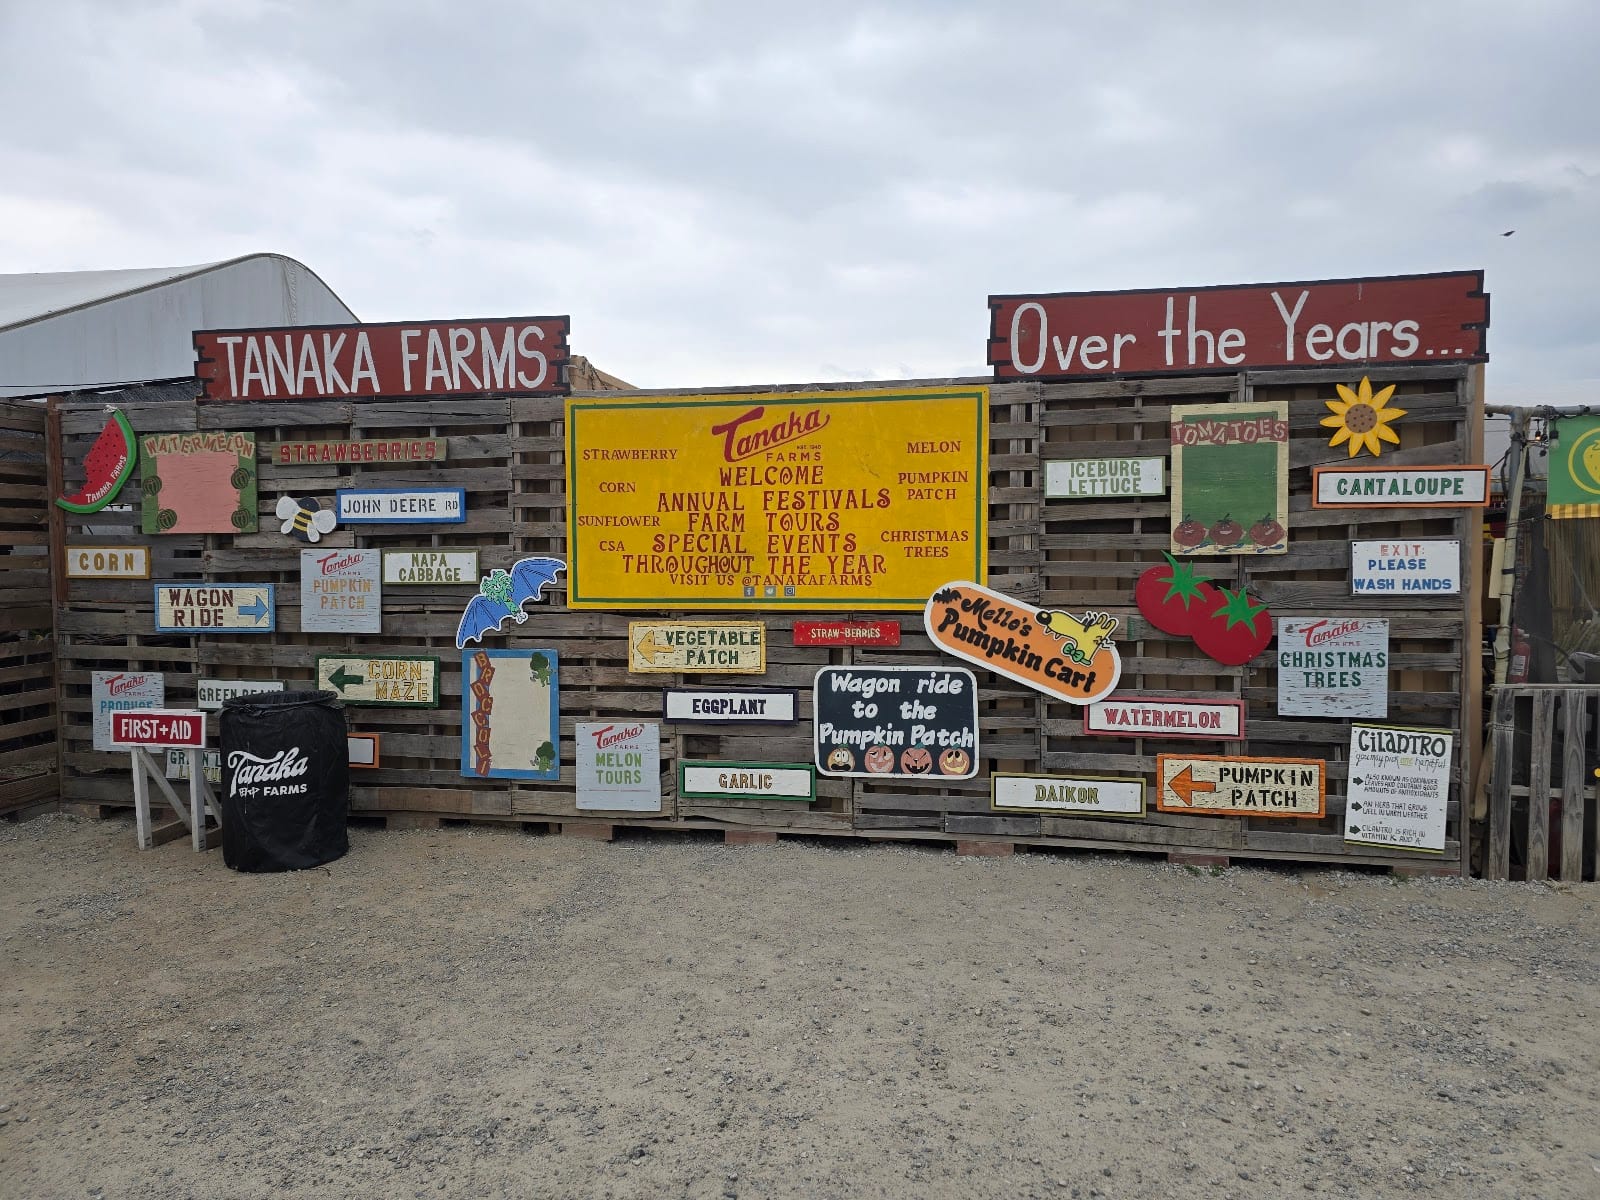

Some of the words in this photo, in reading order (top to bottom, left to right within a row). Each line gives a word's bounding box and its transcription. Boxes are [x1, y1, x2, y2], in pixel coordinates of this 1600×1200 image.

[1010, 302, 1136, 374] Over
[1157, 295, 1246, 366] the
[1271, 289, 1464, 362] Years...
[216, 331, 380, 397] TANAKA
[400, 325, 548, 392] FARMS
[711, 406, 830, 462] Tanaka
[1172, 418, 1287, 445] TOMATOES
[145, 433, 253, 457] WATERMELON
[280, 440, 437, 463] STRAWBERRIES
[906, 440, 962, 454] MELON
[583, 448, 678, 461] STRAWBERRY
[766, 452, 821, 462] FARMS
[110, 454, 127, 480] FARMS
[1070, 460, 1141, 478] ICEBURG
[719, 465, 824, 487] WELCOME
[897, 471, 969, 485] PUMPKIN
[599, 481, 636, 493] CORN
[907, 488, 957, 500] PATCH
[1068, 477, 1142, 494] LETTUCE
[1336, 477, 1464, 496] CANTALOUPE
[343, 499, 381, 514] JOHN
[389, 498, 437, 513] DEERE
[445, 499, 459, 511] RD
[656, 491, 745, 512] ANNUAL
[762, 488, 891, 511] FESTIVALS
[578, 515, 661, 527] SUNFLOWER
[687, 512, 745, 532] FARM
[766, 511, 840, 532] TOURS
[652, 533, 747, 553] SPECIAL
[767, 533, 857, 554] EVENTS
[880, 530, 969, 543] CHRISTMAS
[599, 540, 625, 552] CSA
[903, 546, 949, 558] TREES
[79, 552, 134, 572] CORN
[316, 551, 364, 576] Tanaka
[411, 553, 448, 567] NAPA
[622, 554, 754, 574] THROUGHOUT
[768, 555, 811, 575] THE
[827, 554, 887, 574] YEAR
[1368, 559, 1427, 571] PLEASE
[398, 567, 461, 582] CABBAGE
[670, 574, 710, 586] VISIT
[717, 574, 735, 586] US
[742, 574, 873, 587] @TANAKAFARMS
[313, 578, 371, 593] PUMPKIN
[1354, 578, 1395, 590] WASH
[1402, 578, 1452, 590] HANDS
[168, 588, 234, 608] WAGON
[321, 595, 365, 609] PATCH
[173, 608, 224, 627] RIDE
[665, 630, 760, 646] VEGETABLE
[1298, 619, 1364, 648] Tanaka
[686, 650, 739, 665] PATCH
[938, 608, 1043, 672] Pumpkin
[1044, 657, 1097, 693] Cart
[1280, 651, 1387, 668] CHRISTMAS
[368, 660, 422, 680] CORN
[104, 673, 147, 697] Tanaka
[831, 673, 900, 698] Wagon
[917, 672, 964, 695] ride
[1303, 671, 1362, 688] TREES
[199, 688, 237, 702] GREEN
[375, 681, 428, 702] MAZE
[474, 653, 492, 774] BROCCOLI
[692, 698, 767, 715] EGGPLANT
[852, 700, 878, 719] to
[899, 700, 937, 720] the
[1104, 707, 1222, 729] WATERMELON
[591, 725, 643, 750] Tanaka
[819, 723, 904, 750] Pumpkin
[911, 725, 974, 748] Patch
[170, 751, 209, 766] GRN
[595, 752, 642, 767] MELON
[227, 746, 309, 799] Tanaka
[595, 769, 642, 785] TOURS
[718, 773, 773, 789] GARLIC
[1218, 767, 1313, 787] PUMPKIN
[1381, 774, 1401, 782] KNOWN
[263, 783, 308, 797] FARMS
[1034, 783, 1100, 805] DAIKON
[1231, 789, 1298, 808] PATCH
[1374, 801, 1391, 809] HERB
[1391, 802, 1406, 810] THAT
[1402, 811, 1428, 820] WEATHER
[1361, 825, 1393, 834] CILANTRO
[1402, 829, 1417, 838] RICH
[1361, 833, 1388, 841] VITAMIN
